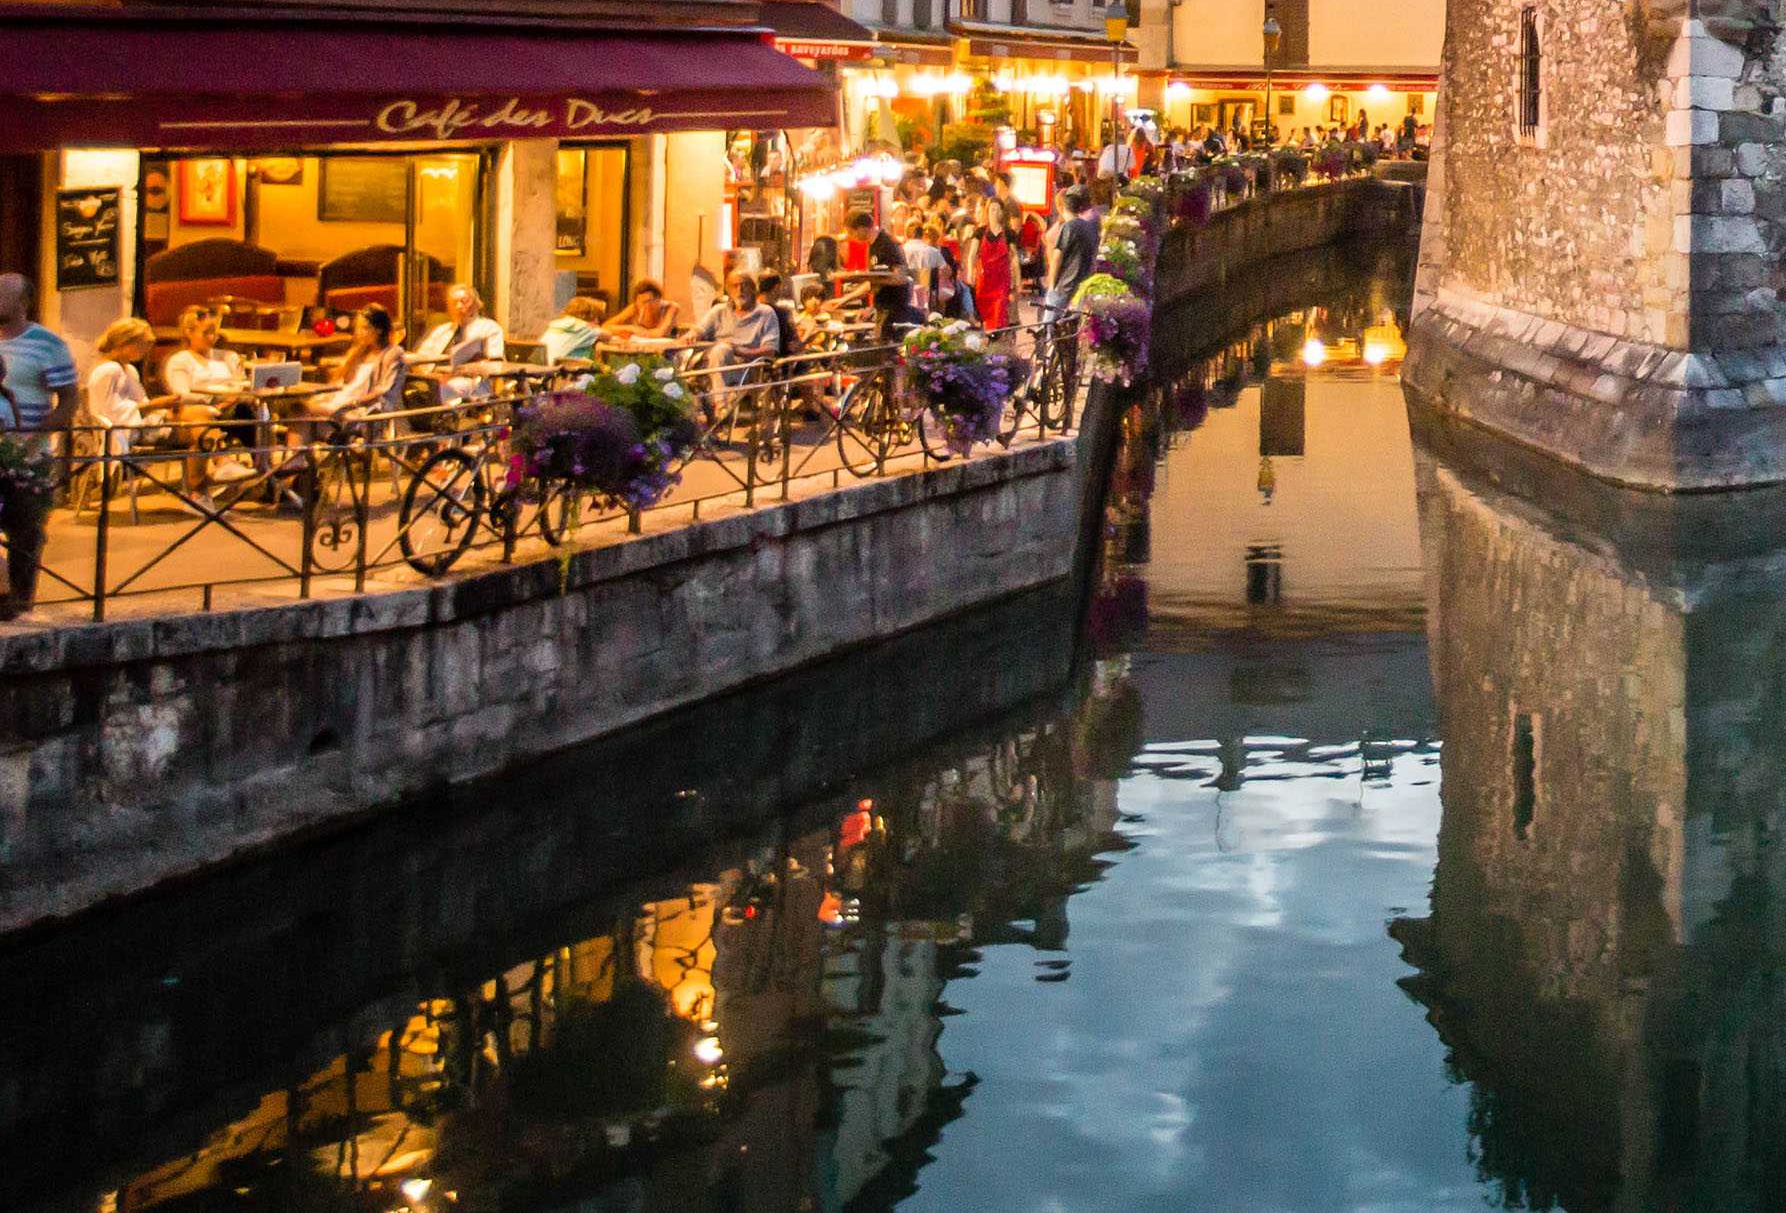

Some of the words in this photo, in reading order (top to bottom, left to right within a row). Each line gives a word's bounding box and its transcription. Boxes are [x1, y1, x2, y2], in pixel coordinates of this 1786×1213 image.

[376, 98, 480, 139] Café
[482, 98, 555, 128] des
[566, 97, 653, 129] Ducs
